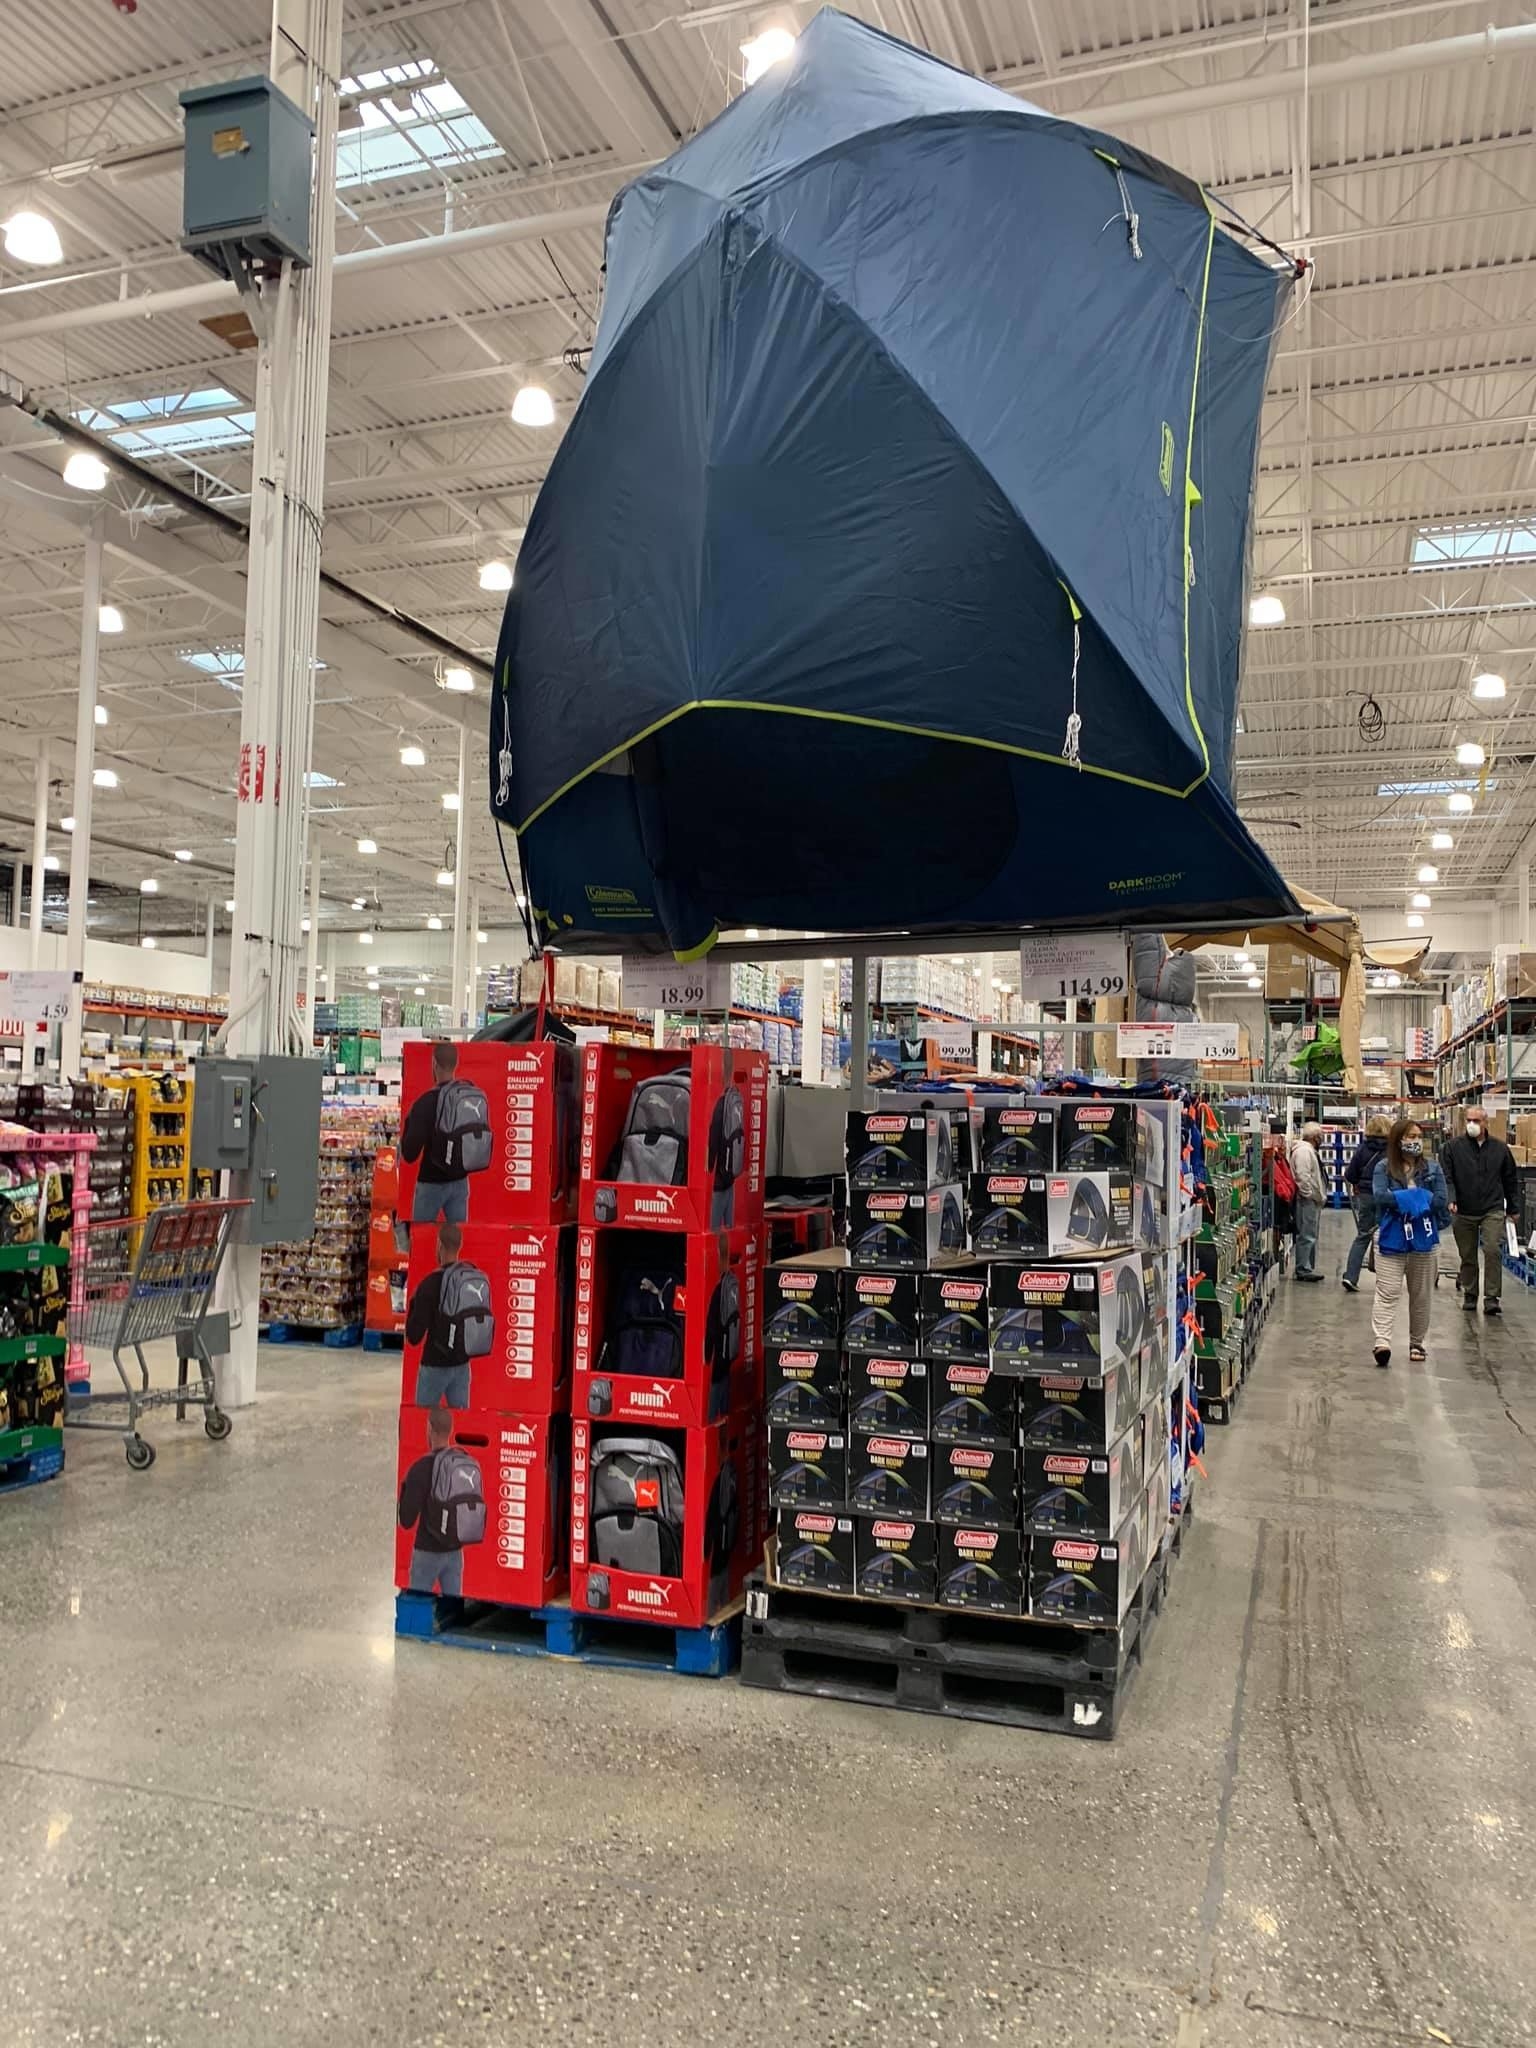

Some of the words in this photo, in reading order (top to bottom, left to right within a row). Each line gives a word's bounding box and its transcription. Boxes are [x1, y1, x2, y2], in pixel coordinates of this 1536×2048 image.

[1059, 976, 1124, 997] 114.99
[661, 987, 704, 1004] 18.99
[41, 1004, 69, 1019] 4.59
[1205, 1047, 1236, 1057] 13.99
[508, 1060, 538, 1072] PUMA
[870, 1118, 897, 1128] Coleman
[990, 1179, 1018, 1189] Coleman
[634, 1199, 668, 1214] PUMA
[870, 1196, 897, 1206] Coleman
[510, 1243, 539, 1256] PUMA
[782, 1275, 809, 1286] Coleman
[859, 1279, 888, 1290] Coleman
[1023, 1274, 1058, 1286] Coleman
[944, 1284, 975, 1296] Coleman
[1024, 1291, 1042, 1300] DARK
[944, 1299, 960, 1308] DARK
[782, 1352, 808, 1363] Coleman
[870, 1361, 899, 1373] Coleman
[950, 1367, 980, 1380] Coleman
[950, 1383, 966, 1392] DARK
[630, 1392, 665, 1408] PUMA
[501, 1431, 530, 1445] PUMA
[790, 1434, 818, 1445] Coleman
[871, 1439, 900, 1452] Coleman
[954, 1450, 984, 1463] Coleman
[1049, 1457, 1080, 1469] Coleman
[799, 1515, 826, 1527] Coleman
[876, 1523, 905, 1536] Coleman
[958, 1532, 988, 1545] Coleman
[958, 1548, 974, 1557] DARK
[1056, 1542, 1089, 1556] Coleman
[1056, 1559, 1073, 1568] DARK
[628, 1589, 661, 1605] PUMA
